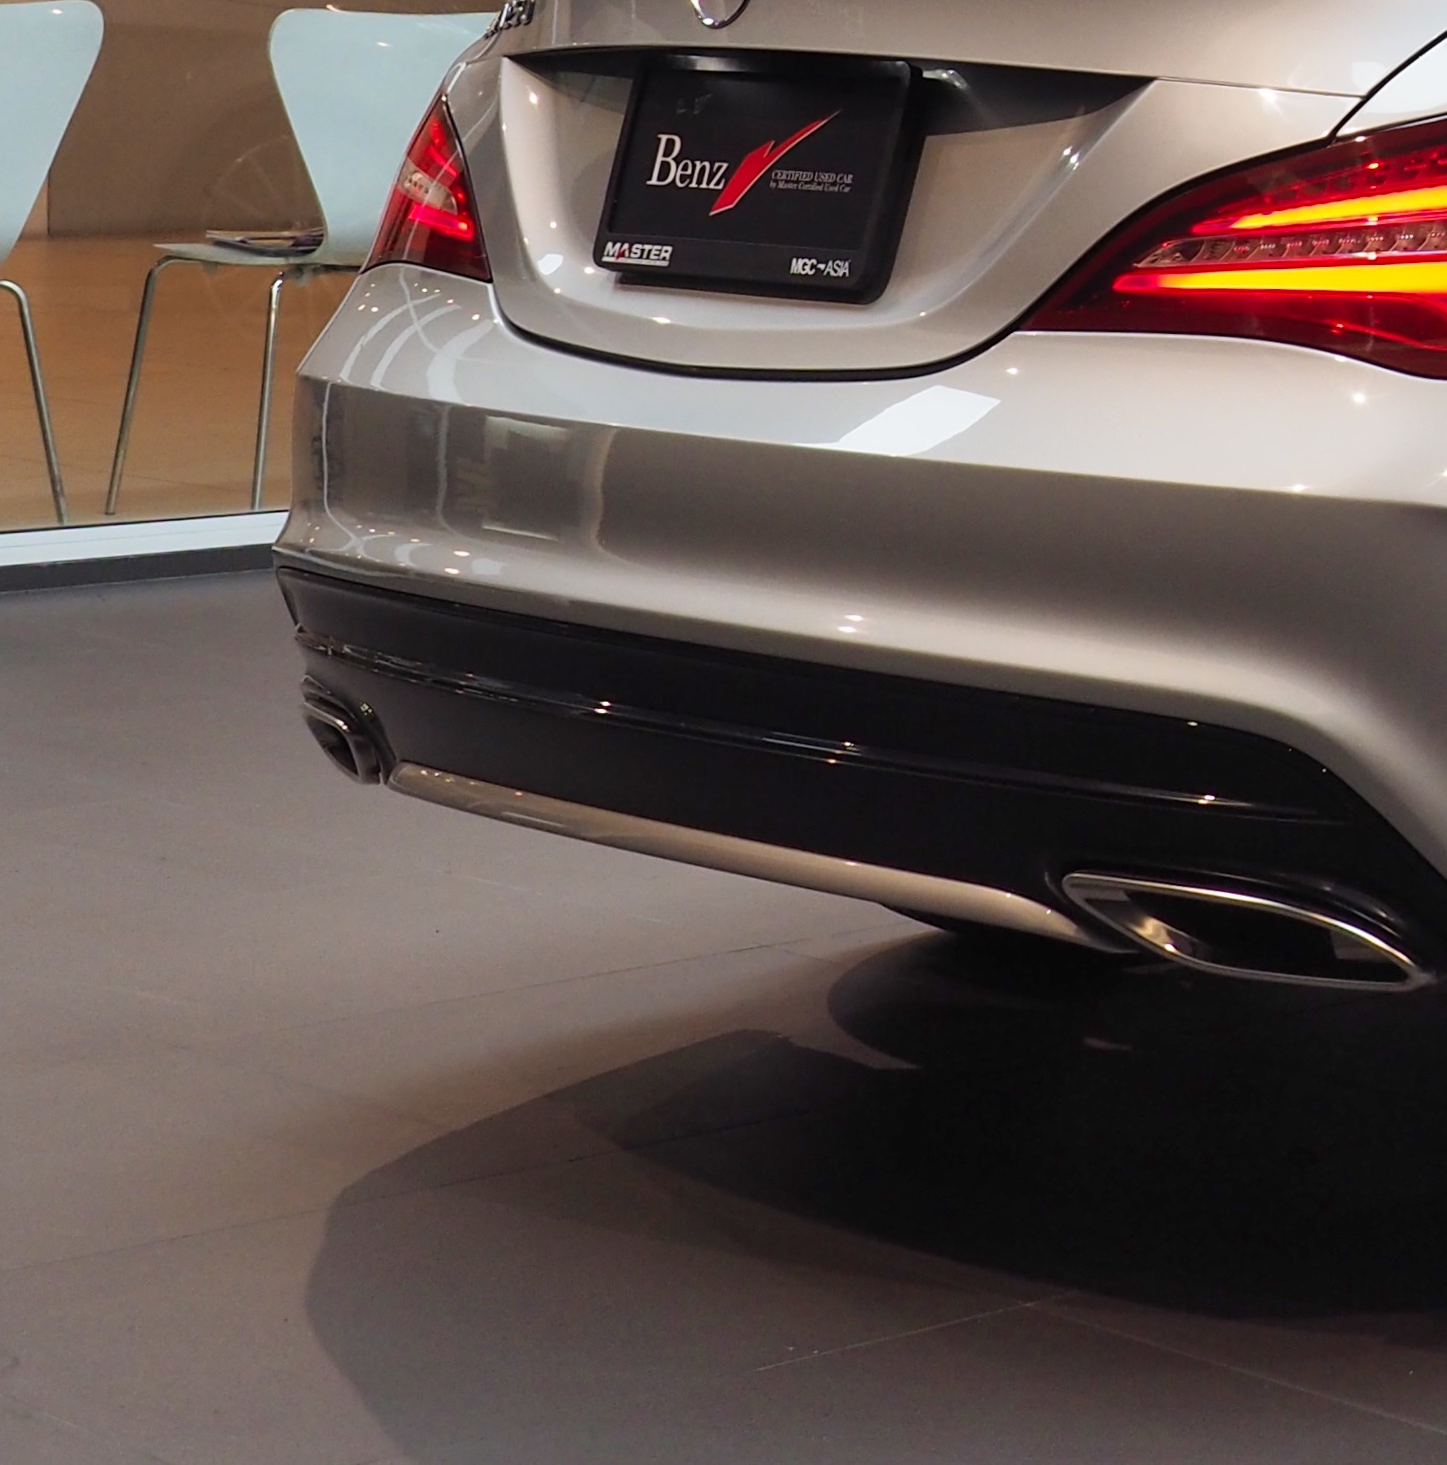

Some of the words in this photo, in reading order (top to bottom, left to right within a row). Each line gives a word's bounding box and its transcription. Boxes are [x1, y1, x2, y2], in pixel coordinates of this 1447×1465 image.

[645, 133, 729, 190] Benz
[771, 169, 814, 182] CERTIFIED
[814, 171, 836, 183] USED
[837, 173, 854, 184] CAR
[603, 241, 673, 261] MASTER
